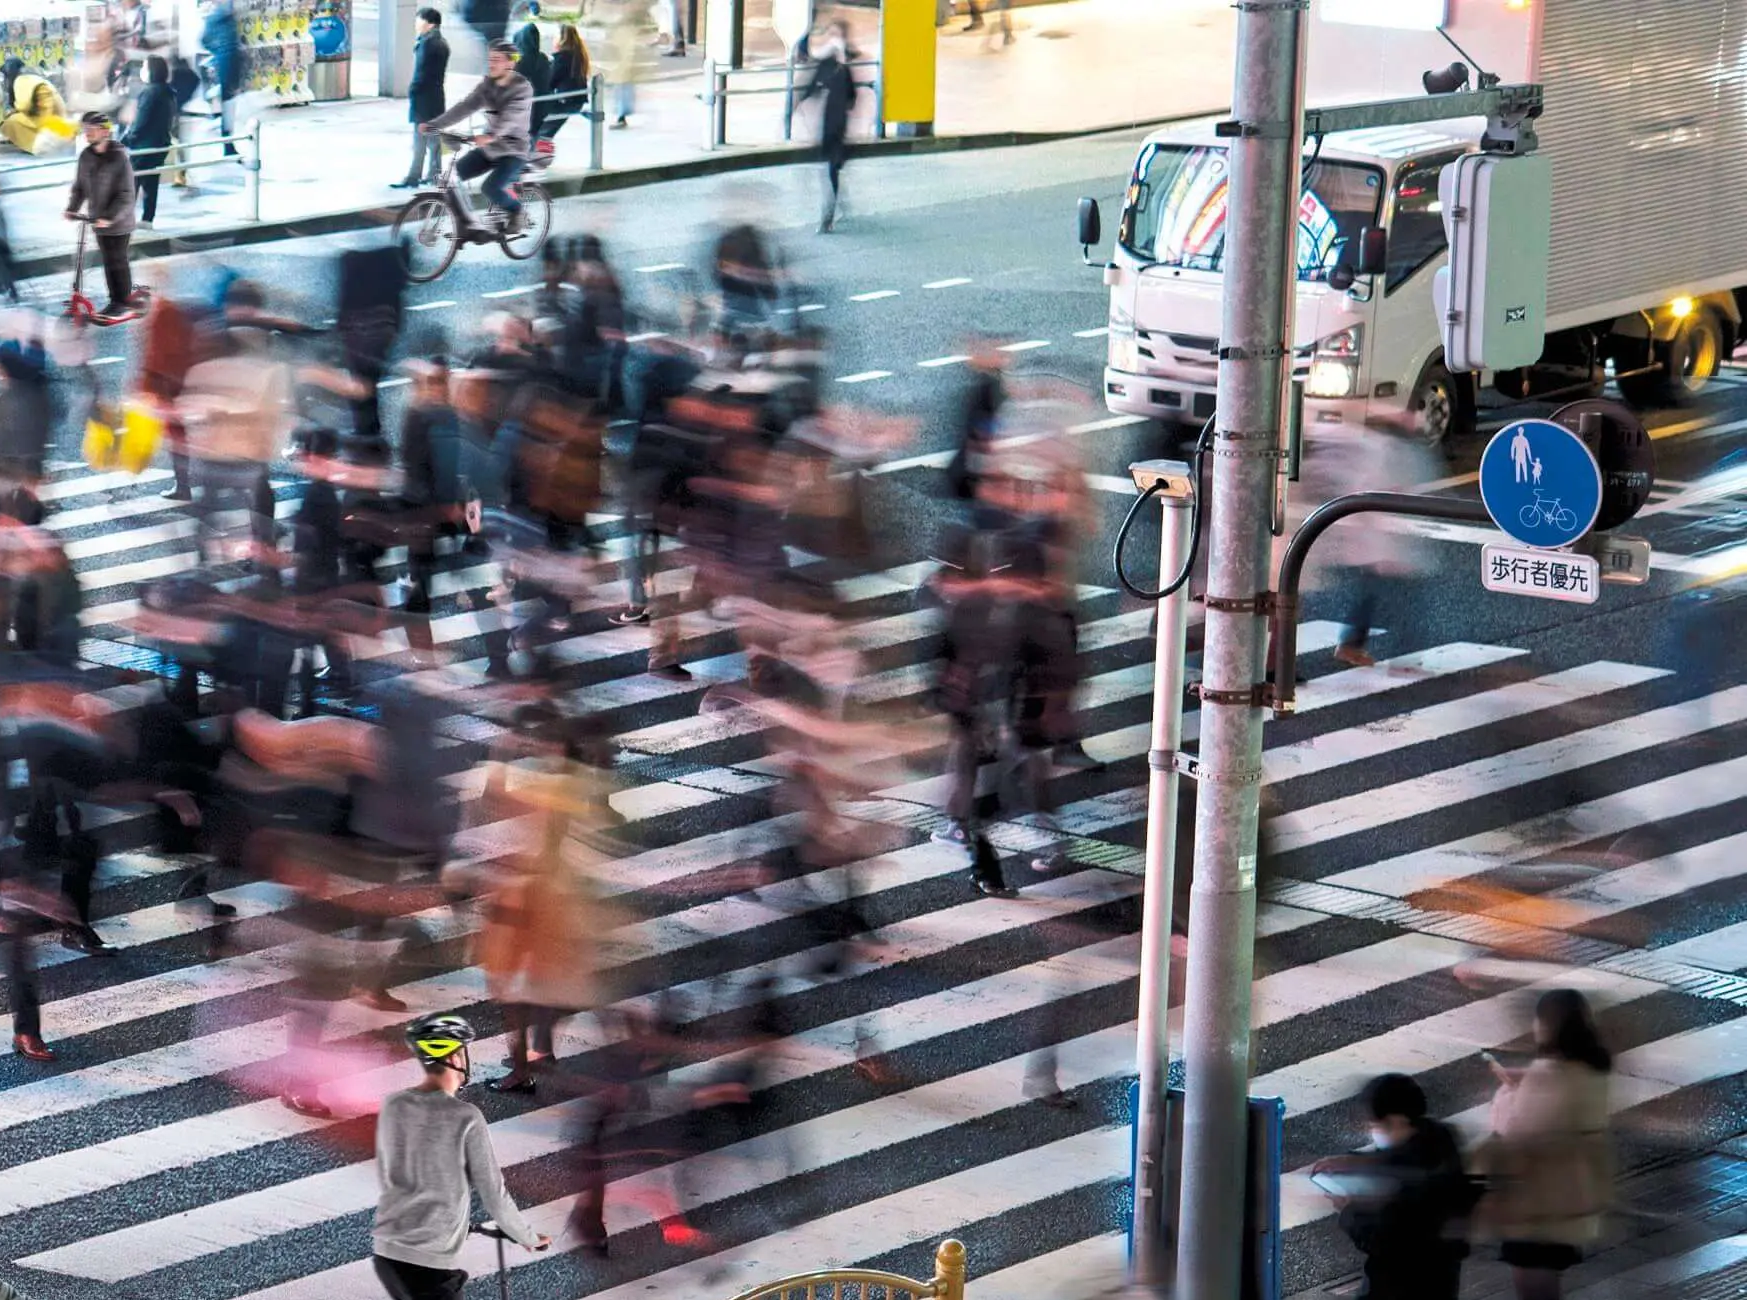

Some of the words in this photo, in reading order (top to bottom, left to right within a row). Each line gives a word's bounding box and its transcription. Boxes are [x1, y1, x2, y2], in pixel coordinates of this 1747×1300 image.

[1491, 555, 1589, 593] 歩行者優先
